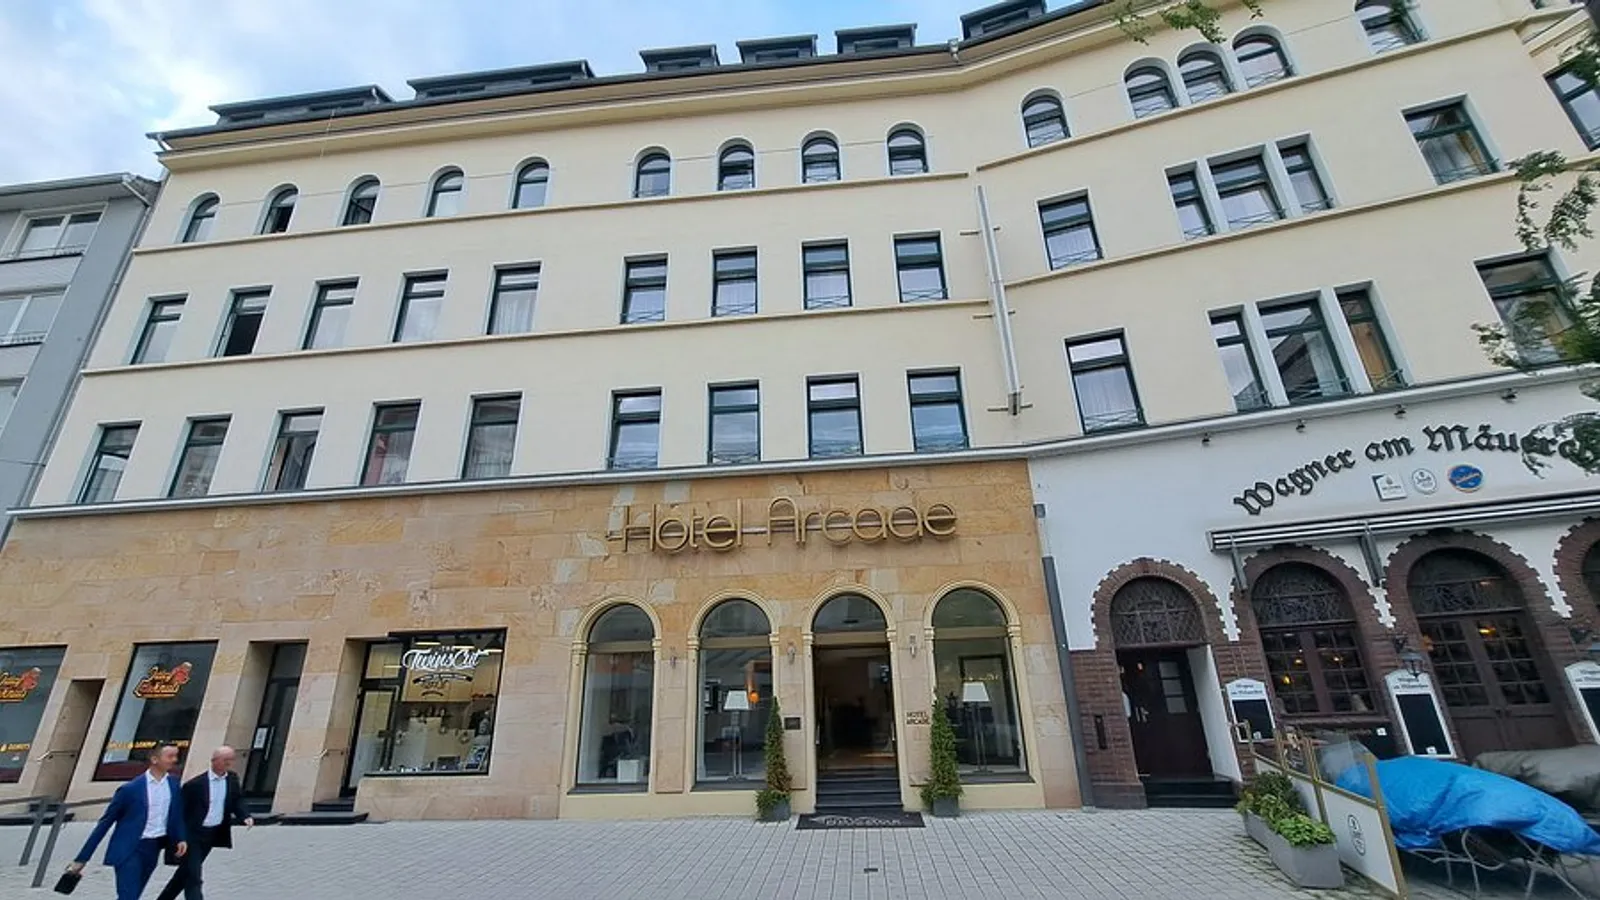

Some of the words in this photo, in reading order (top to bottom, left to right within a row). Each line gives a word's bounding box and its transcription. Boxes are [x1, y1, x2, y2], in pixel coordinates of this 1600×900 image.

[1233, 449, 1356, 516] Wagner
[1364, 435, 1415, 462] am
[623, 498, 743, 554] Hotel
[767, 496, 957, 548] Arcade
